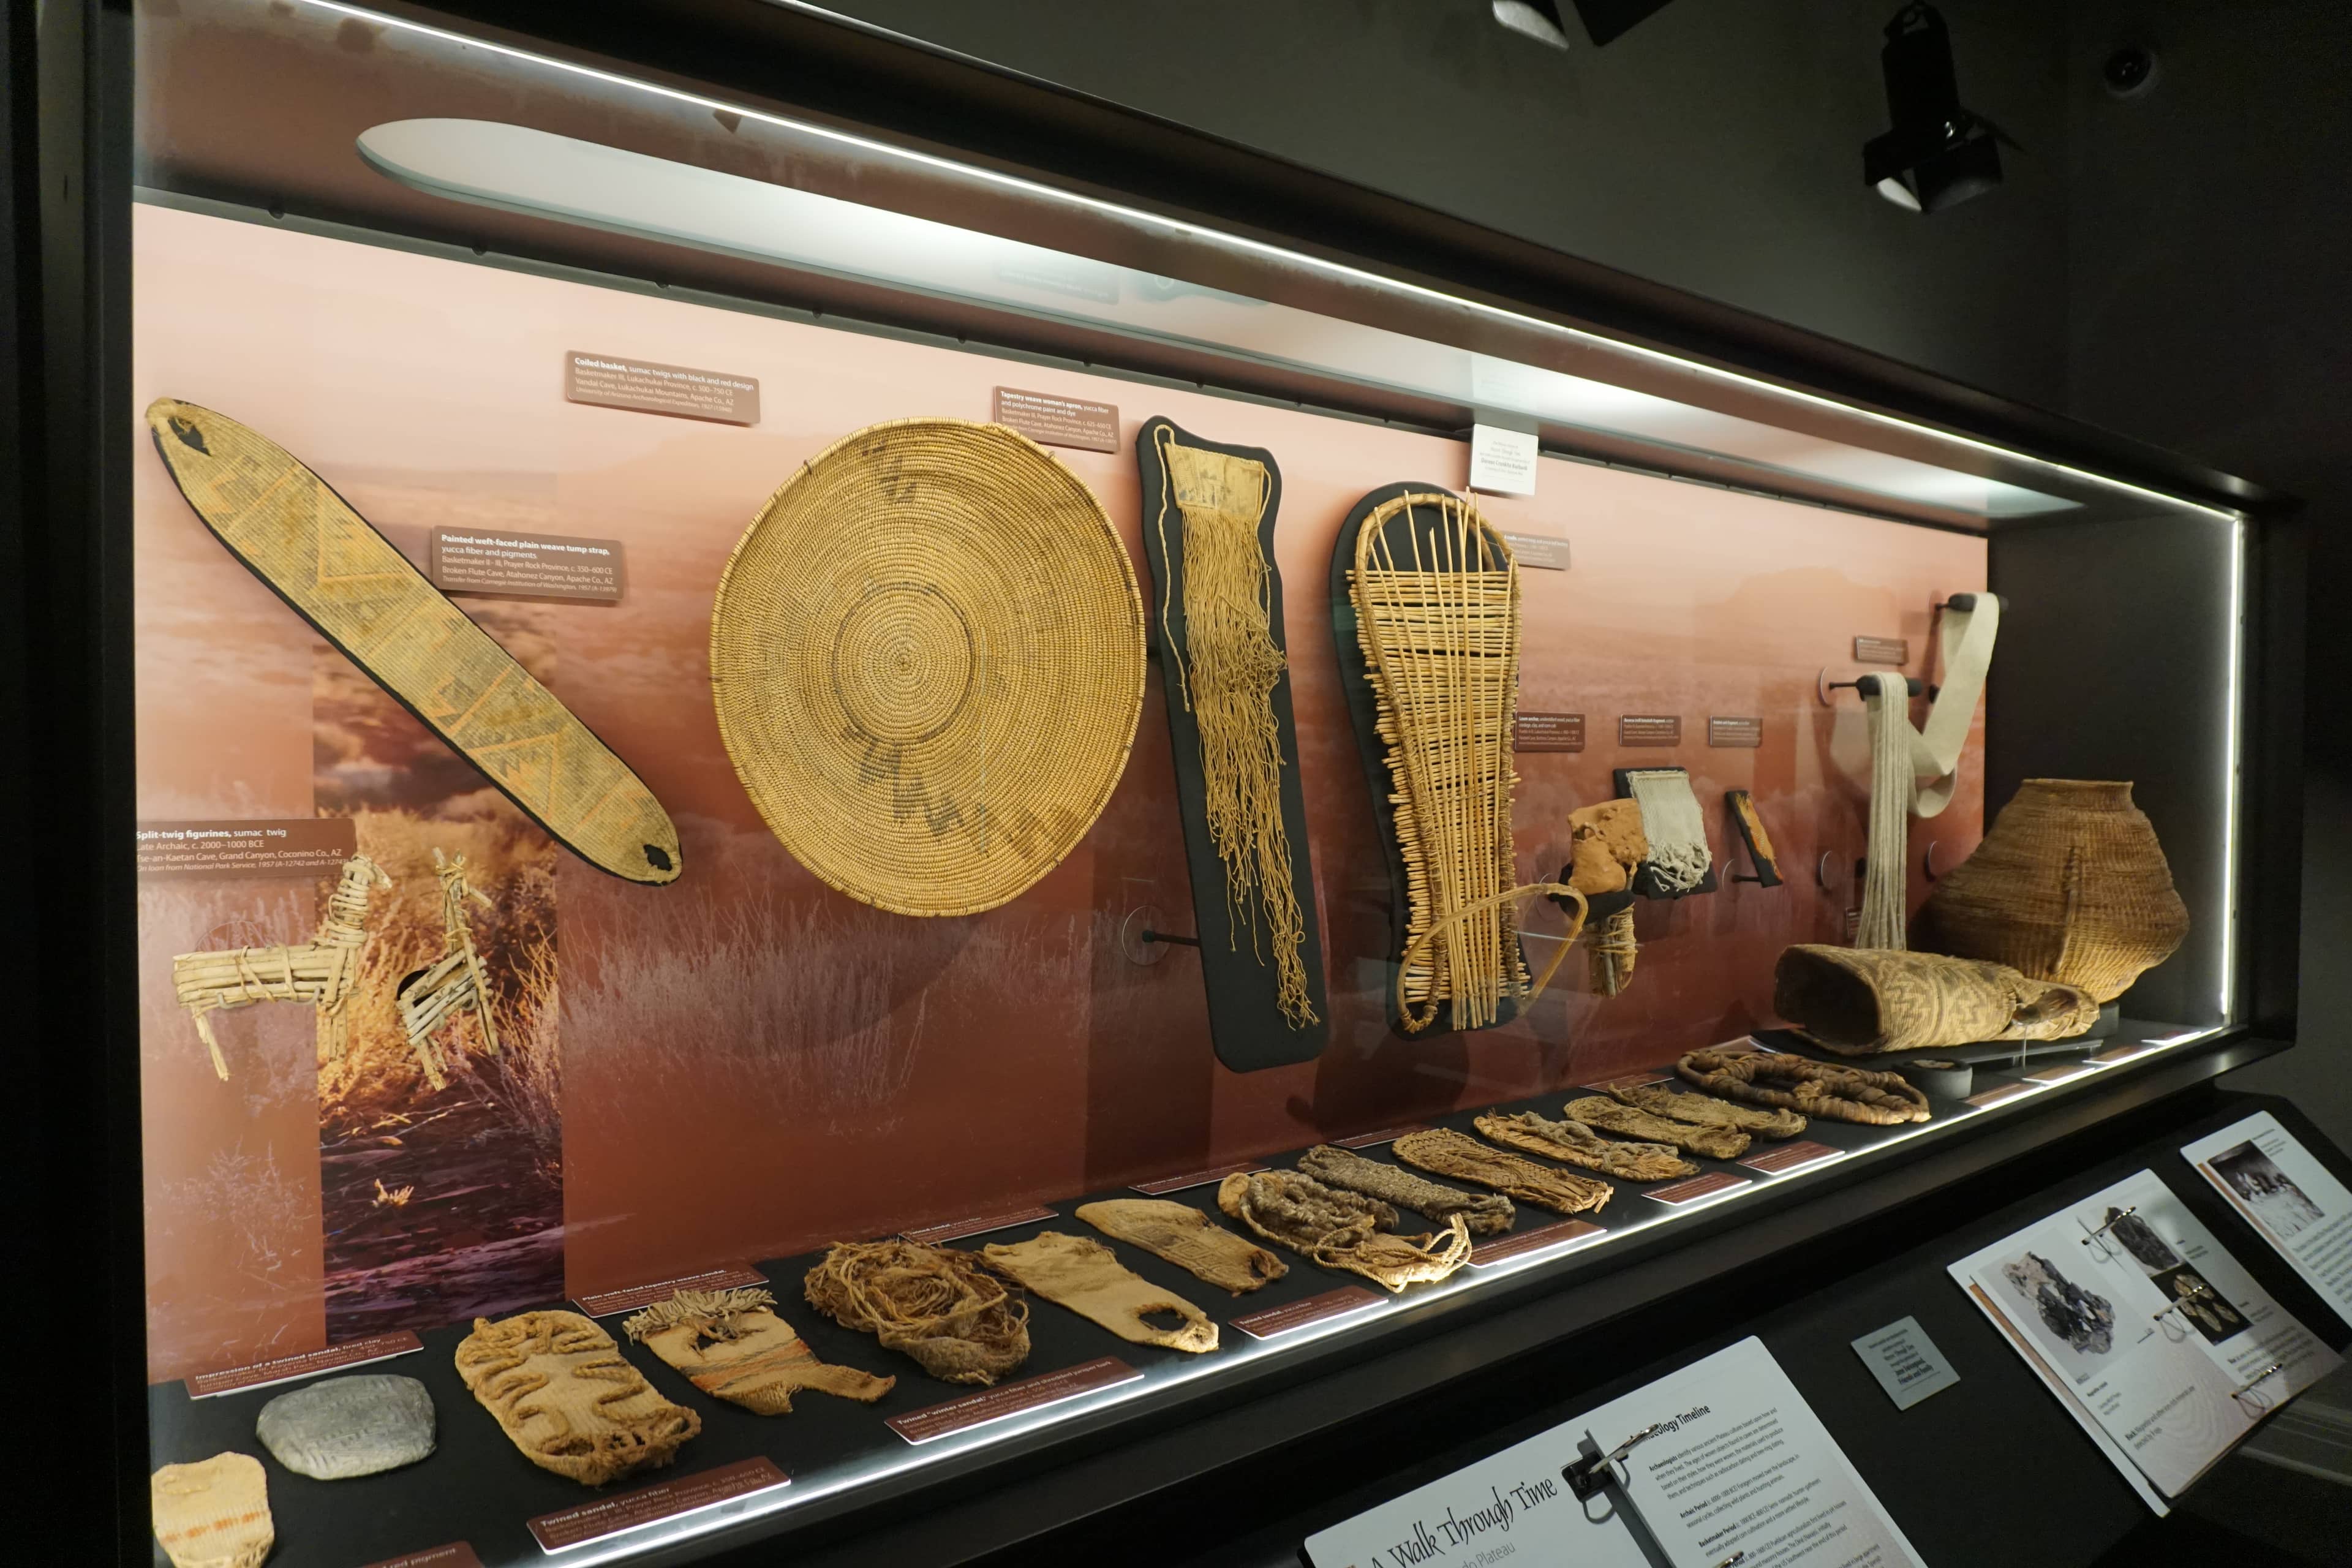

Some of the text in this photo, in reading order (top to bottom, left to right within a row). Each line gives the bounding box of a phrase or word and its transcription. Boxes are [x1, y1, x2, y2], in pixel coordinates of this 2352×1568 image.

[575, 357, 598, 367] Coiled
[600, 361, 627, 372] basket,
[652, 369, 671, 379] twigs
[732, 380, 753, 391] design
[575, 368, 617, 380] Basketmaker
[627, 375, 662, 386] Lukachukai
[663, 380, 690, 391] Province,
[575, 377, 598, 386] Vandal
[599, 381, 616, 390] Cave,
[618, 383, 654, 394] Lukachukai
[655, 388, 687, 400] Mountains,
[690, 393, 712, 404] Apache
[1001, 391, 1024, 401] Tapestry
[1001, 407, 1030, 416] Basketmaker
[1012, 401, 1042, 412] polychrome
[441, 534, 473, 543] Painted
[475, 537, 517, 547] weft-faced
[519, 541, 538, 550] plain
[567, 545, 587, 554] tump
[589, 546, 609, 556] strap,
[442, 556, 484, 565] Basketmaker
[503, 560, 523, 570] Prayer
[541, 563, 570, 572] Province,
[481, 578, 506, 587] Carnegie
[539, 573, 565, 582] Canyon,
[566, 575, 590, 584] Apache
[137, 831, 183, 840] Split-twig
[186, 830, 232, 839] figurines,
[266, 829, 286, 838] twig
[245, 851, 276, 861] Canyon,
[195, 1366, 251, 1381] Impression
[271, 1354, 306, 1363] twined
[895, 1414, 929, 1424] Twined
[1676, 1404, 1711, 1425] Timeline
[1649, 1455, 1678, 1472] Archaeologists
[541, 1512, 581, 1526] Twined
[619, 1494, 649, 1506] yucca
[647, 1487, 671, 1496] fiber
[1680, 1508, 1695, 1517] Archaic
[1387, 1478, 1558, 1568] Walk Through Time
[1698, 1524, 1736, 1545] Basketmaker Period
[410, 1548, 456, 1566] pigment
[1476, 1542, 1516, 1566] Plateau
